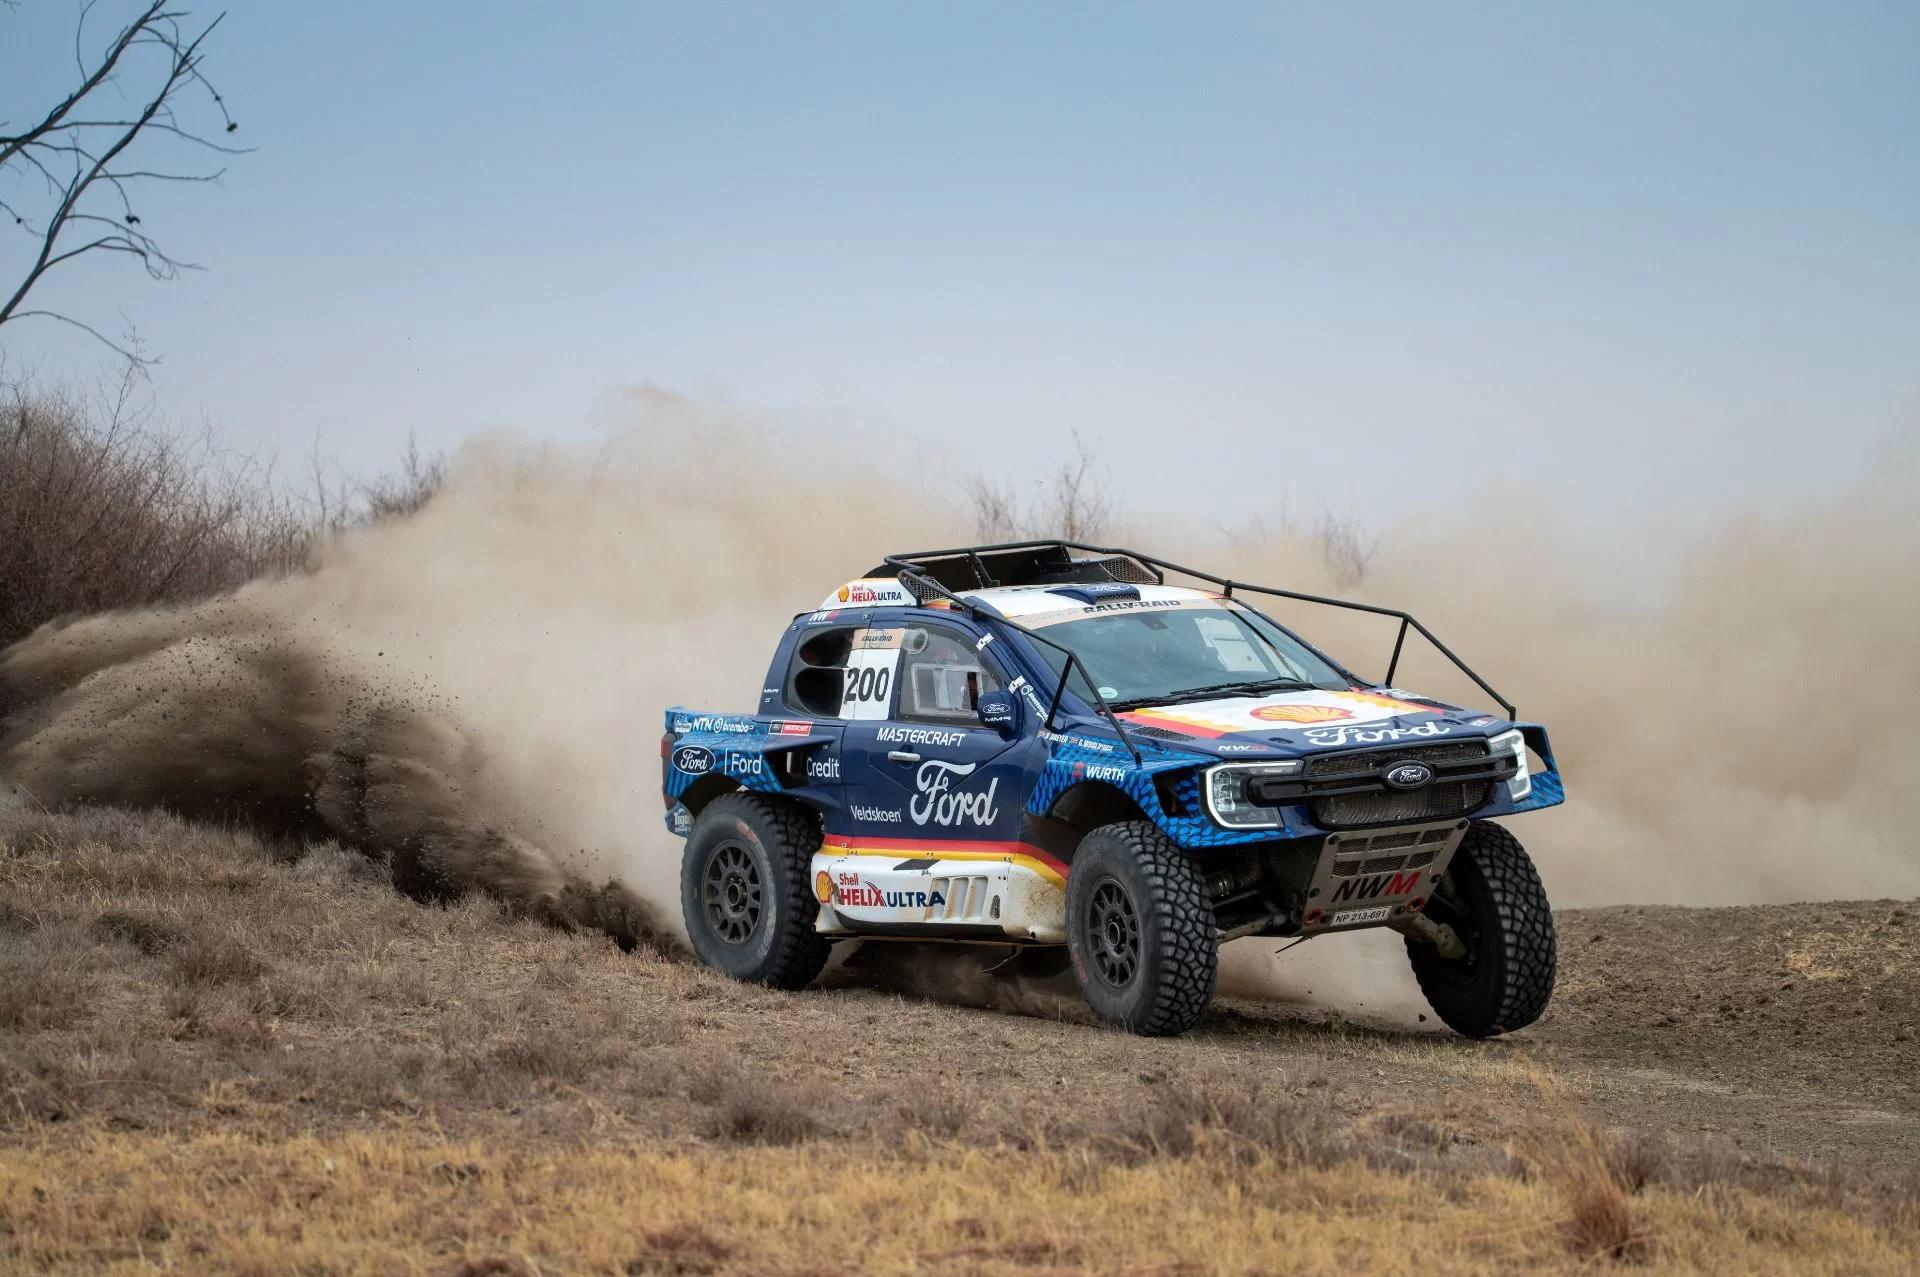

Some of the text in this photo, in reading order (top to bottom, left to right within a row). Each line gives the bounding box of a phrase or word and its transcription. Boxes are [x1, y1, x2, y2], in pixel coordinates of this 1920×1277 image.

[852, 590, 902, 602] HELIX ULTRA
[1082, 600, 1181, 614] RALLY-RAID
[844, 667, 890, 702] 200
[693, 717, 714, 732] NTN
[722, 720, 749, 733] brembo
[1302, 721, 1451, 746] Ford
[876, 727, 966, 747] MASTERCRAFT
[680, 748, 708, 770] Ford
[731, 752, 840, 778] Ford Credit
[1400, 768, 1423, 781] Ford
[910, 759, 999, 826] Ford
[839, 872, 859, 886] Shell
[1331, 870, 1421, 902] NWM
[839, 887, 946, 908] HELIX ULTRA
[1335, 910, 1386, 923] NP 213-691
